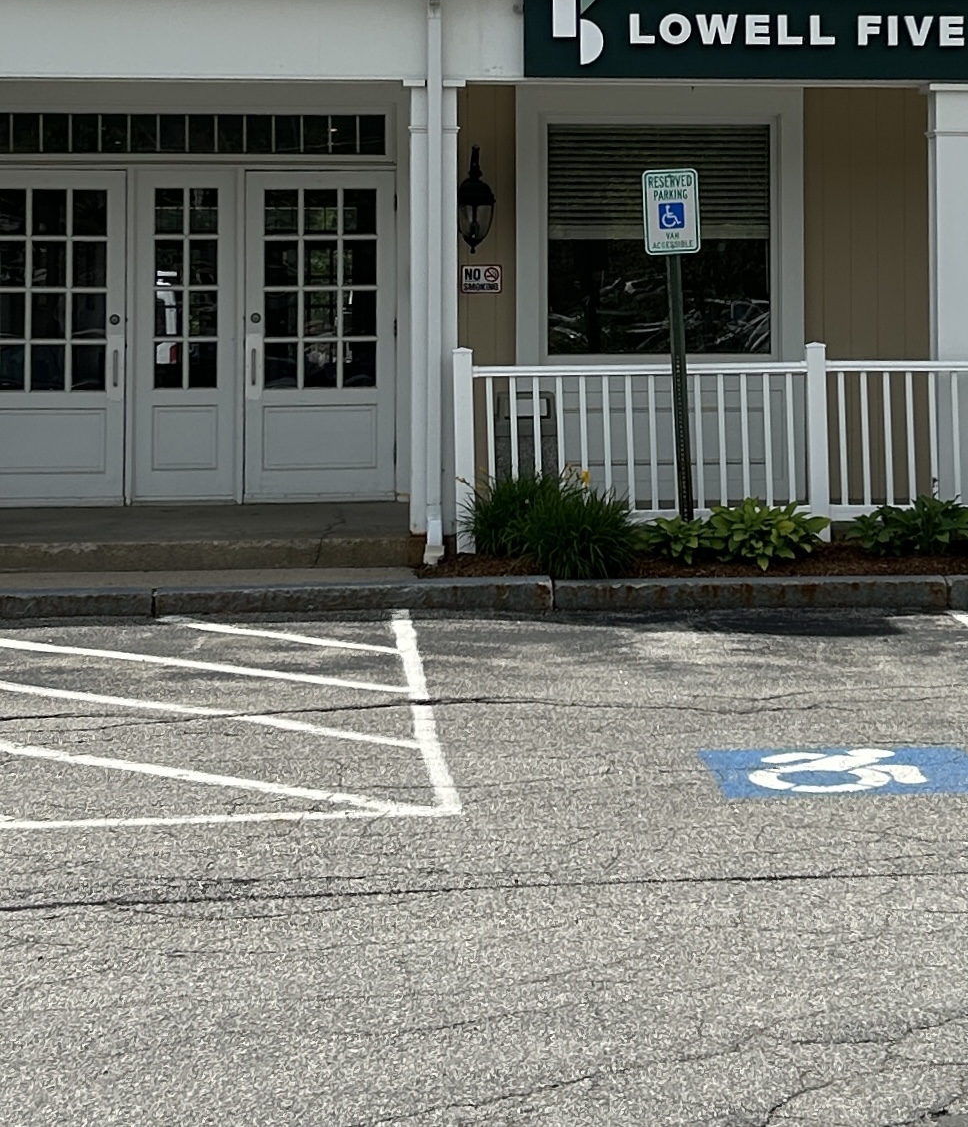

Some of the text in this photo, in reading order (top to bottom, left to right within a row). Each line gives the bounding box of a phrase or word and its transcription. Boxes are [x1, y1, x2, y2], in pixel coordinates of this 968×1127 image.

[629, 13, 836, 46] LOWELL
[857, 15, 965, 47] FIVE
[648, 175, 693, 188] RESERVED
[653, 189, 688, 201] PARKING
[665, 232, 680, 240] VAN
[652, 240, 694, 249] ACCESSIBLE
[464, 268, 481, 281] NO
